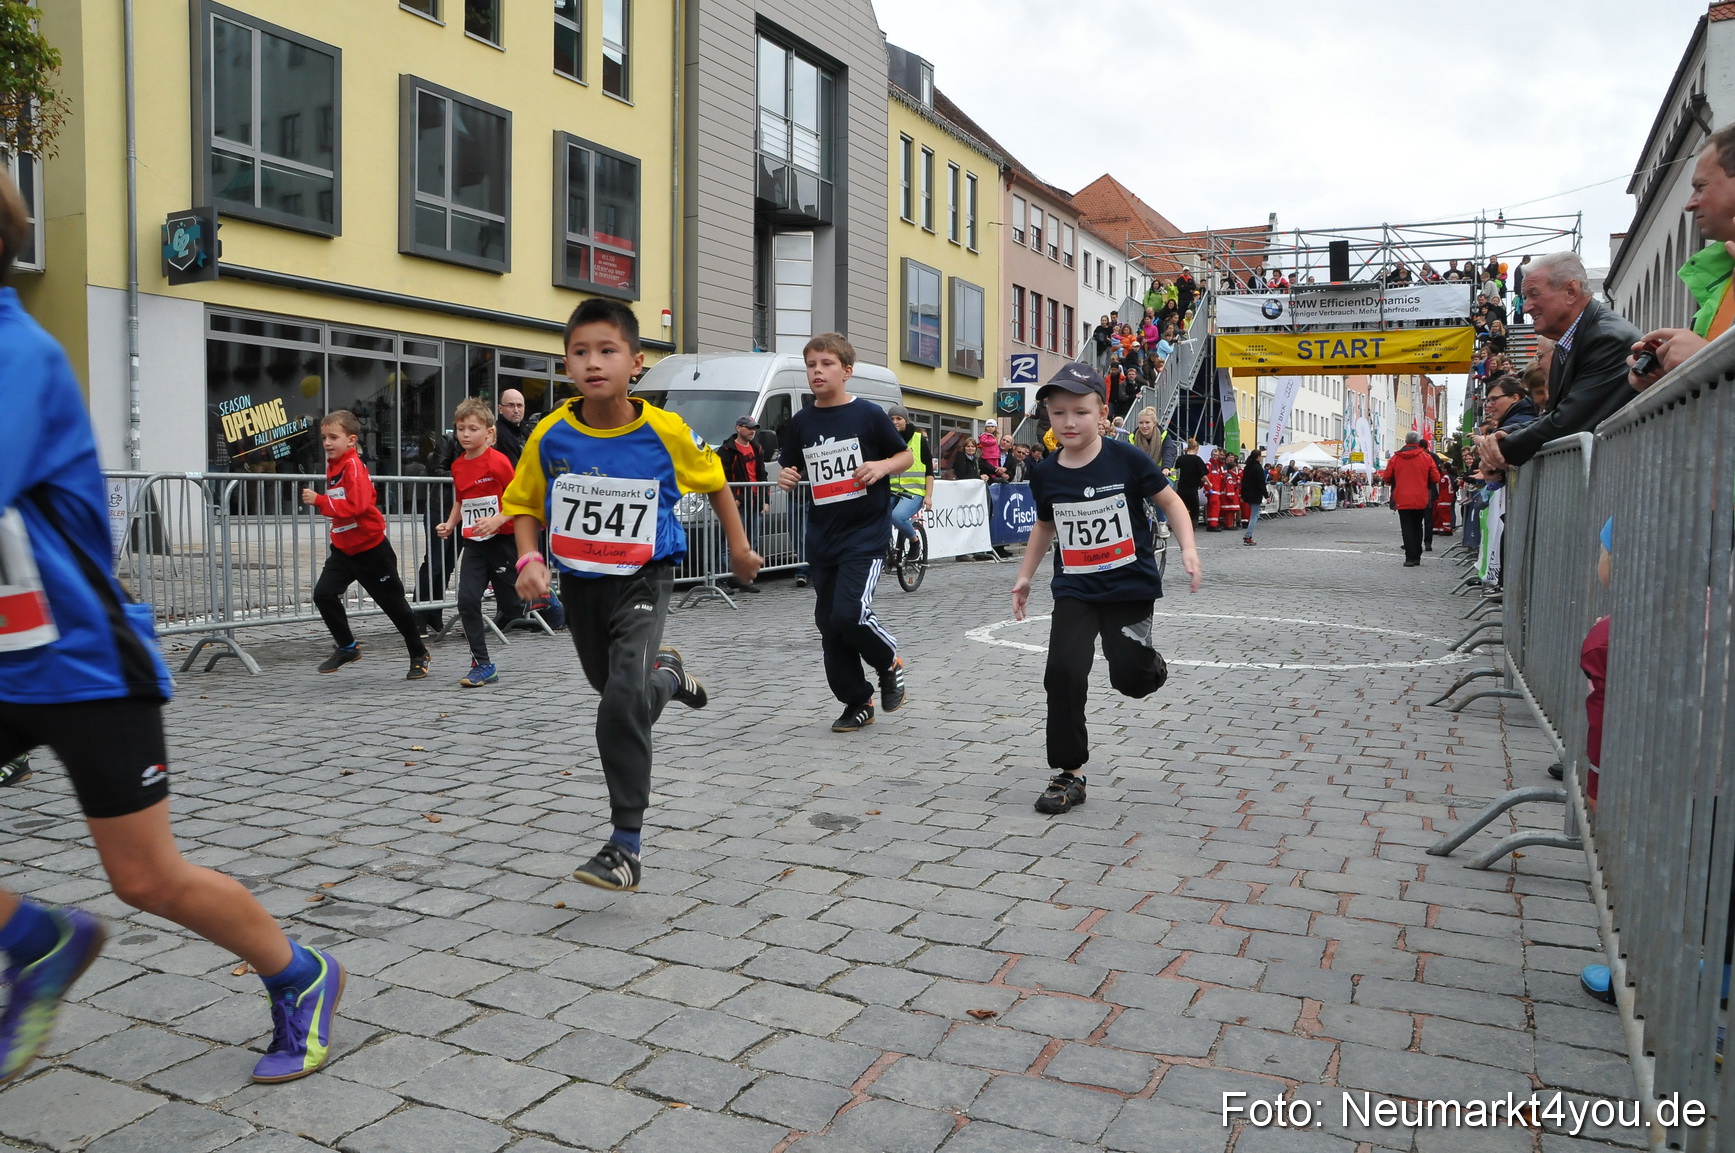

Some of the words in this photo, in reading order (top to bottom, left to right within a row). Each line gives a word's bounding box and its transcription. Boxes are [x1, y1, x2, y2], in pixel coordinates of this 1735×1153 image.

[1288, 300, 1317, 309] BMW
[1320, 295, 1421, 309] EfficientDynamics
[1289, 310, 1318, 318] Weniger
[1319, 308, 1357, 317] Verbrauch.
[1359, 307, 1378, 315] Mehr
[1297, 338, 1386, 360] START
[219, 394, 251, 417] SEASON
[221, 398, 288, 444] OPENING
[821, 446, 850, 457] Neumarkt
[810, 454, 858, 482] 7544
[555, 481, 588, 495] PARTL
[591, 487, 641, 498] Neumarkt
[562, 497, 648, 538] 7547
[927, 508, 954, 528] BKK
[1013, 506, 1037, 524] Fisch
[1078, 505, 1114, 517] Neumarkt
[1062, 513, 1123, 546] 7521
[582, 543, 627, 557] Julian
